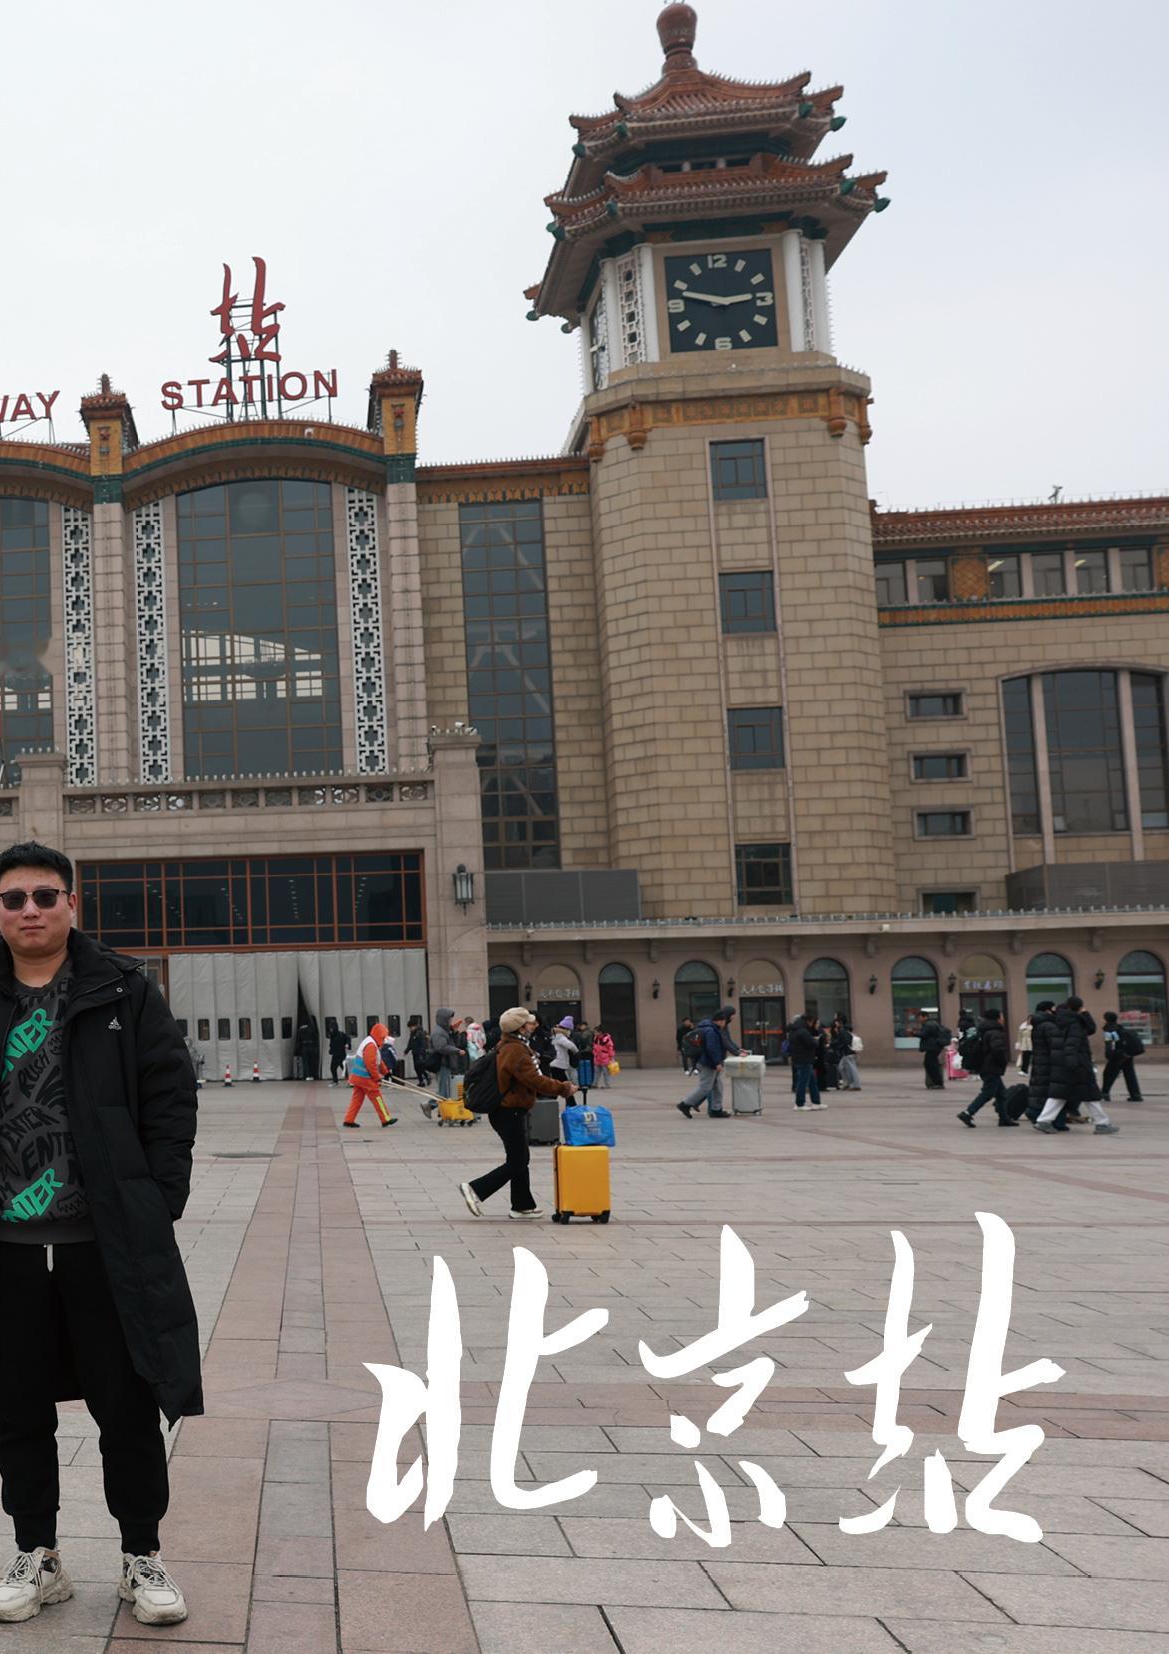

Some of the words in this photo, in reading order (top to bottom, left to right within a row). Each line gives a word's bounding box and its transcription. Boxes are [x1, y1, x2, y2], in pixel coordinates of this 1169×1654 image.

[707, 254, 727, 269] 12
[668, 299, 685, 313] 9
[755, 291, 774, 306] 3
[714, 336, 732, 350] 6
[161, 369, 338, 410] STATION
